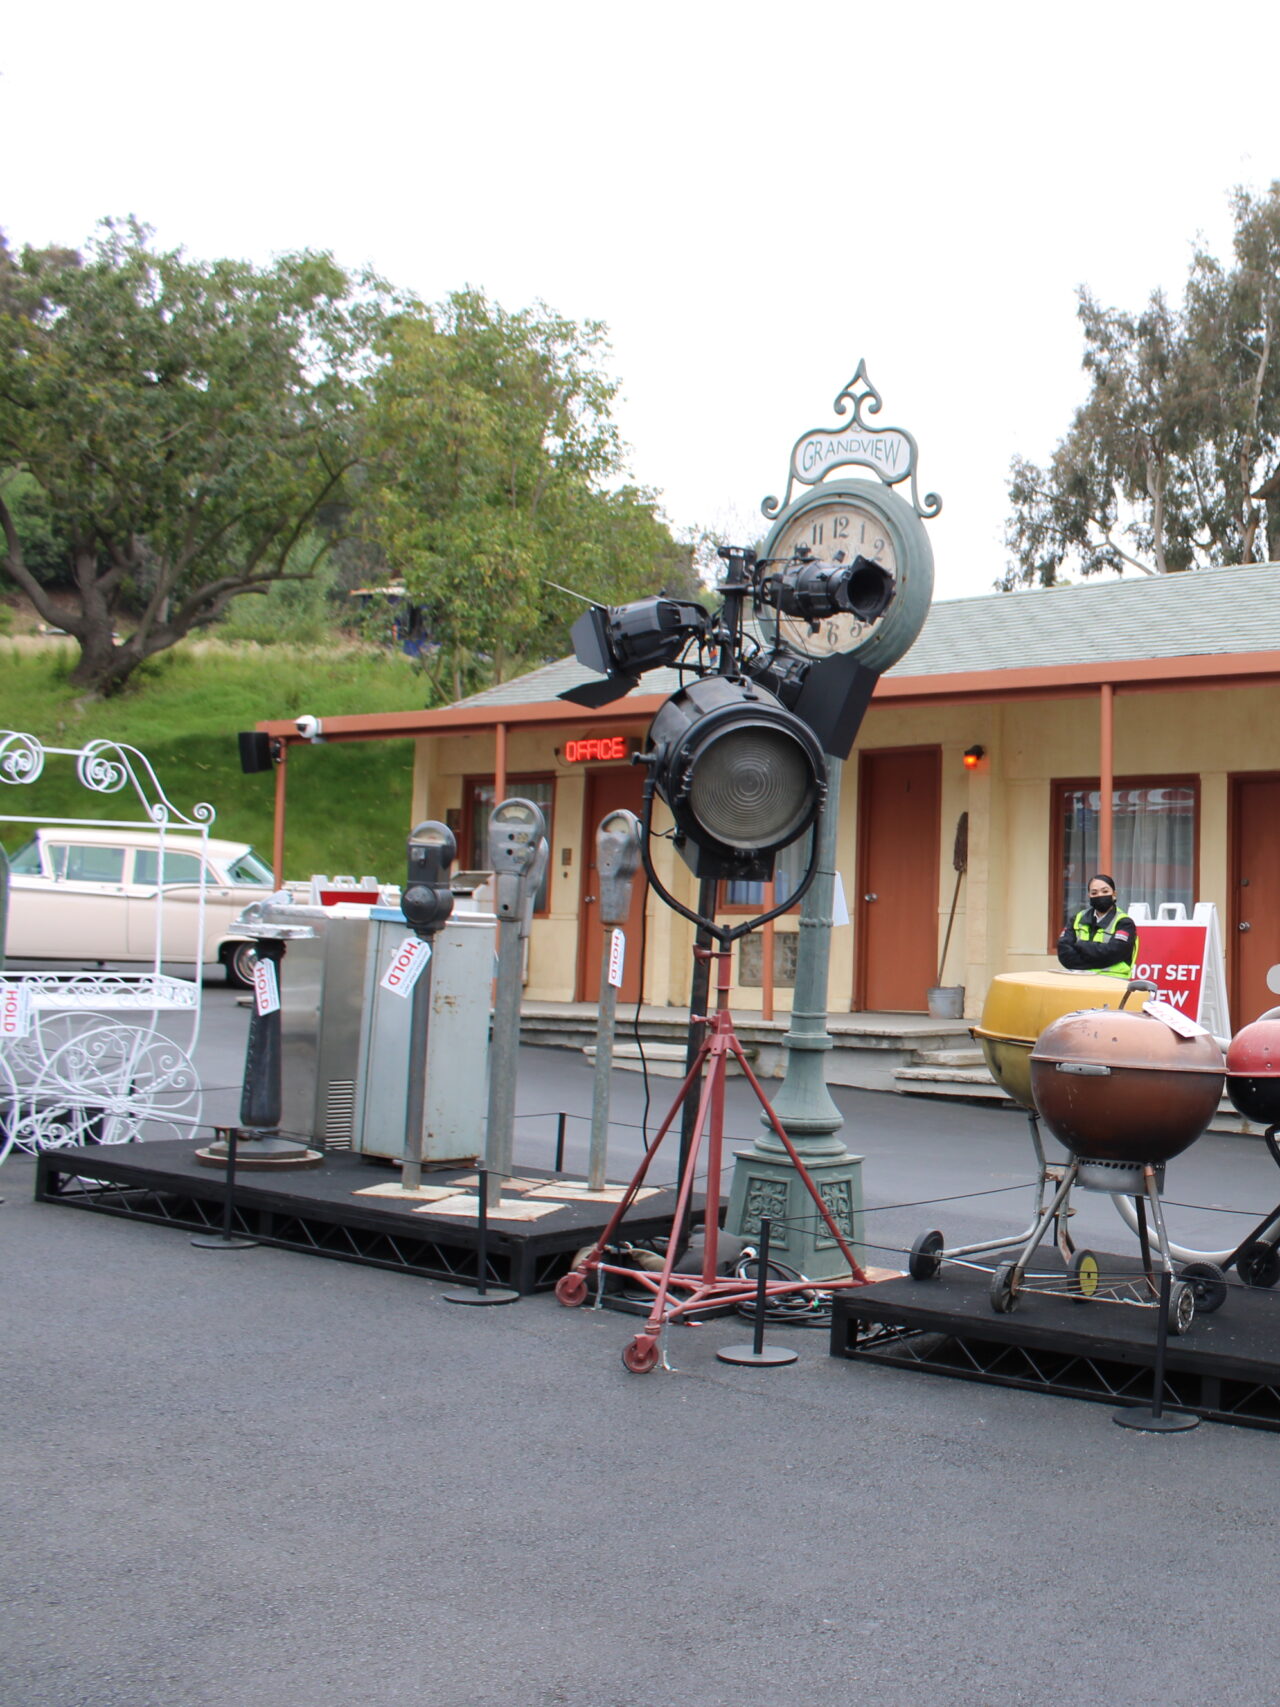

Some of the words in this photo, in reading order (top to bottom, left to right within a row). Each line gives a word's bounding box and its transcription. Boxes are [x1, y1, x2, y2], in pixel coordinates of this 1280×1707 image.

[802, 438, 902, 472] GRANDVIEW
[812, 522, 823, 545] 11
[833, 516, 850, 539] 12
[860, 521, 865, 544] 1
[873, 539, 885, 561] 2
[825, 621, 839, 646] 6
[565, 736, 625, 762] OFFICE
[388, 942, 418, 986] HOLD
[611, 935, 620, 980] HOLD
[1165, 964, 1201, 981] SET
[256, 967, 269, 1009] HOLD
[4, 990, 18, 1032] HOLD
